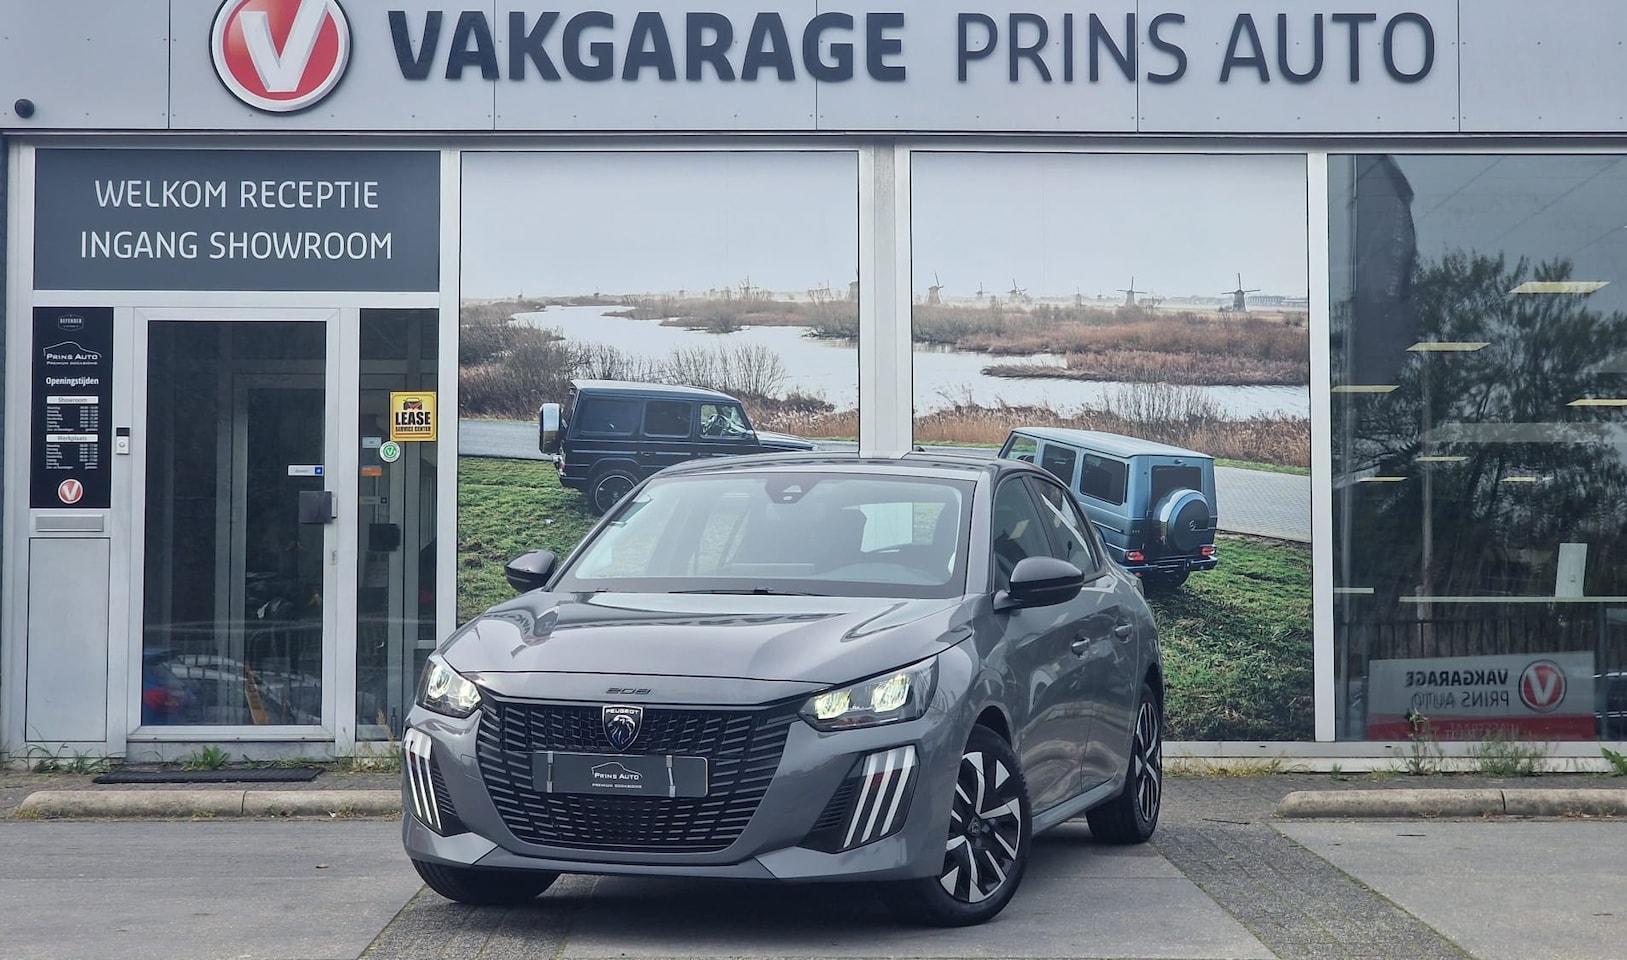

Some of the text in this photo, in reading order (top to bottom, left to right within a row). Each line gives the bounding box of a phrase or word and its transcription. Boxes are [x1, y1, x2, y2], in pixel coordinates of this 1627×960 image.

[387, 10, 1436, 83] VAKGARAGE PRINS AUTO
[94, 180, 379, 208] WELKOM RECEPTIE
[80, 231, 393, 259] INGANG SHOWROOM
[45, 376, 99, 387] Openingstijden
[395, 411, 431, 426] LEASE
